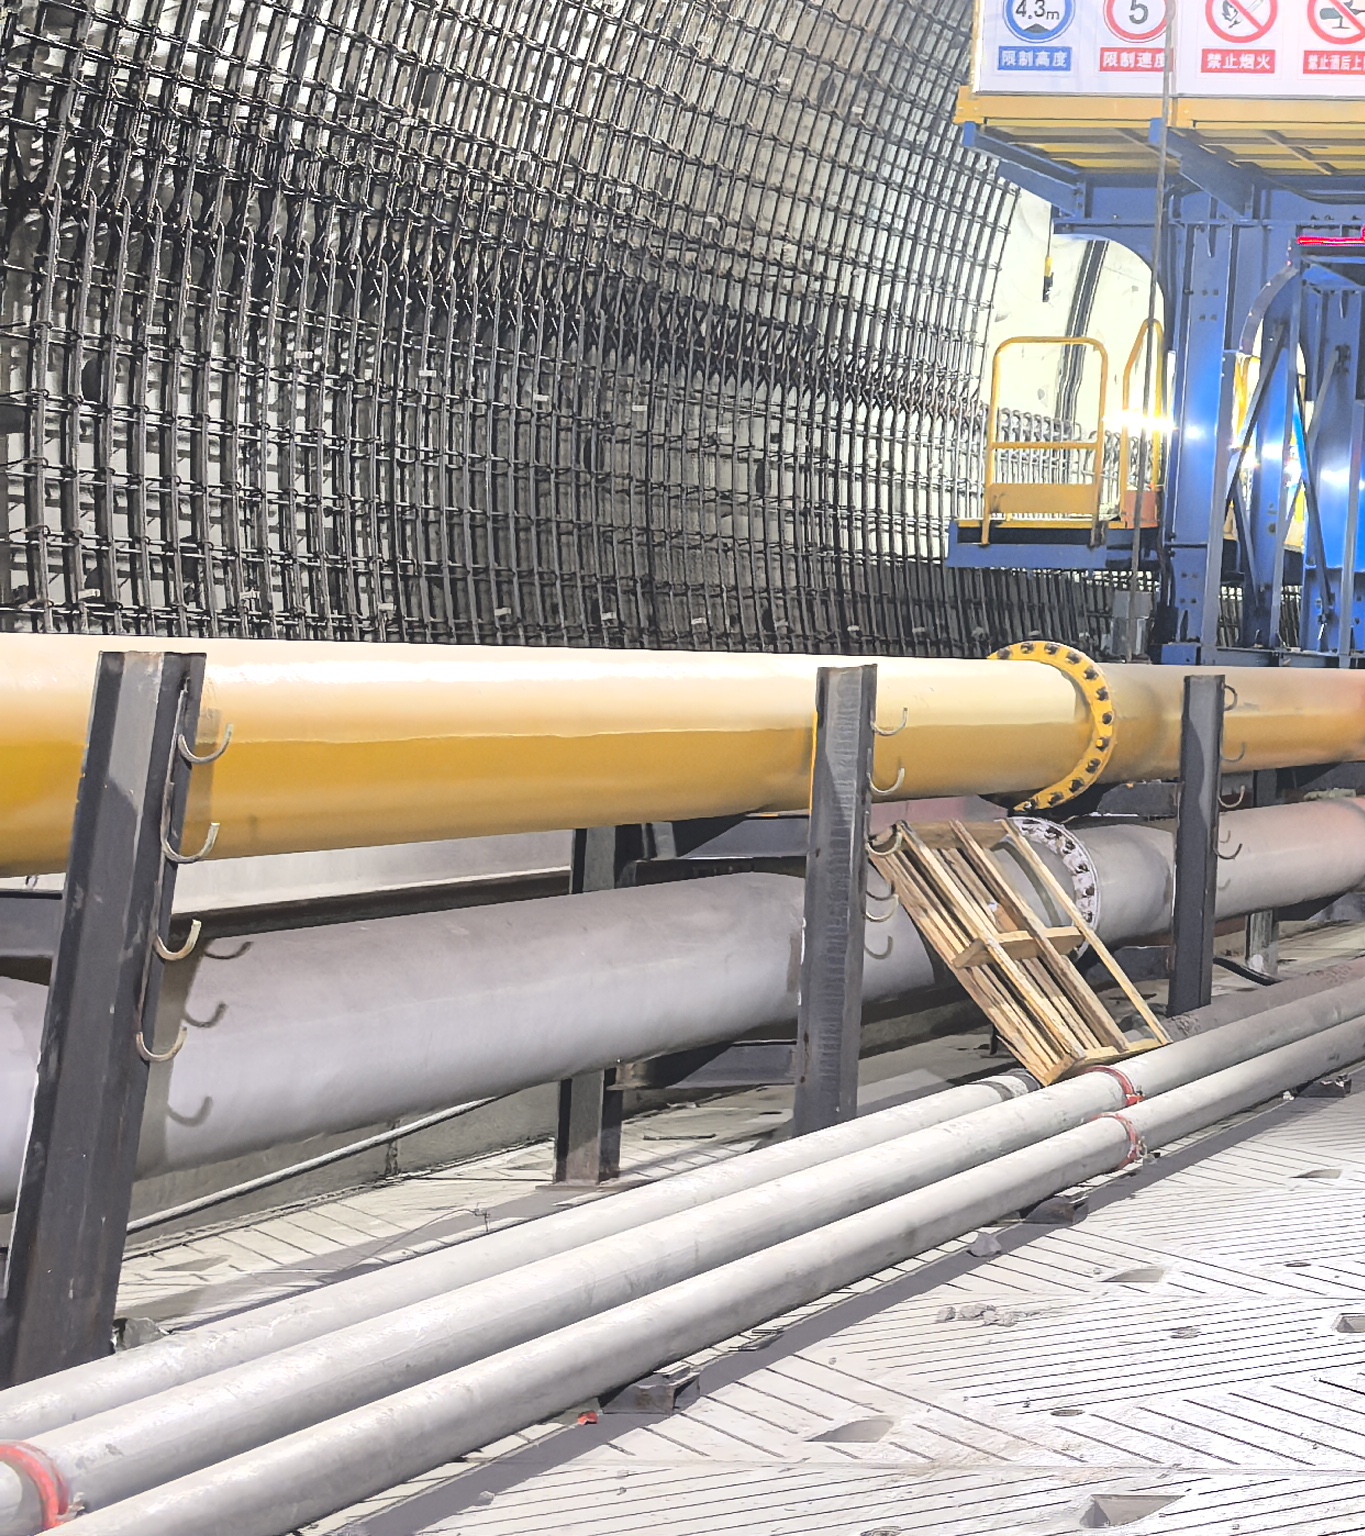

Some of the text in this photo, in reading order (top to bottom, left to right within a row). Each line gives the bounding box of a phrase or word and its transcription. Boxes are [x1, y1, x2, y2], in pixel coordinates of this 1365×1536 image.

[1001, 50, 1068, 68] 限制高度
[1206, 53, 1271, 70] 禁止烟火
